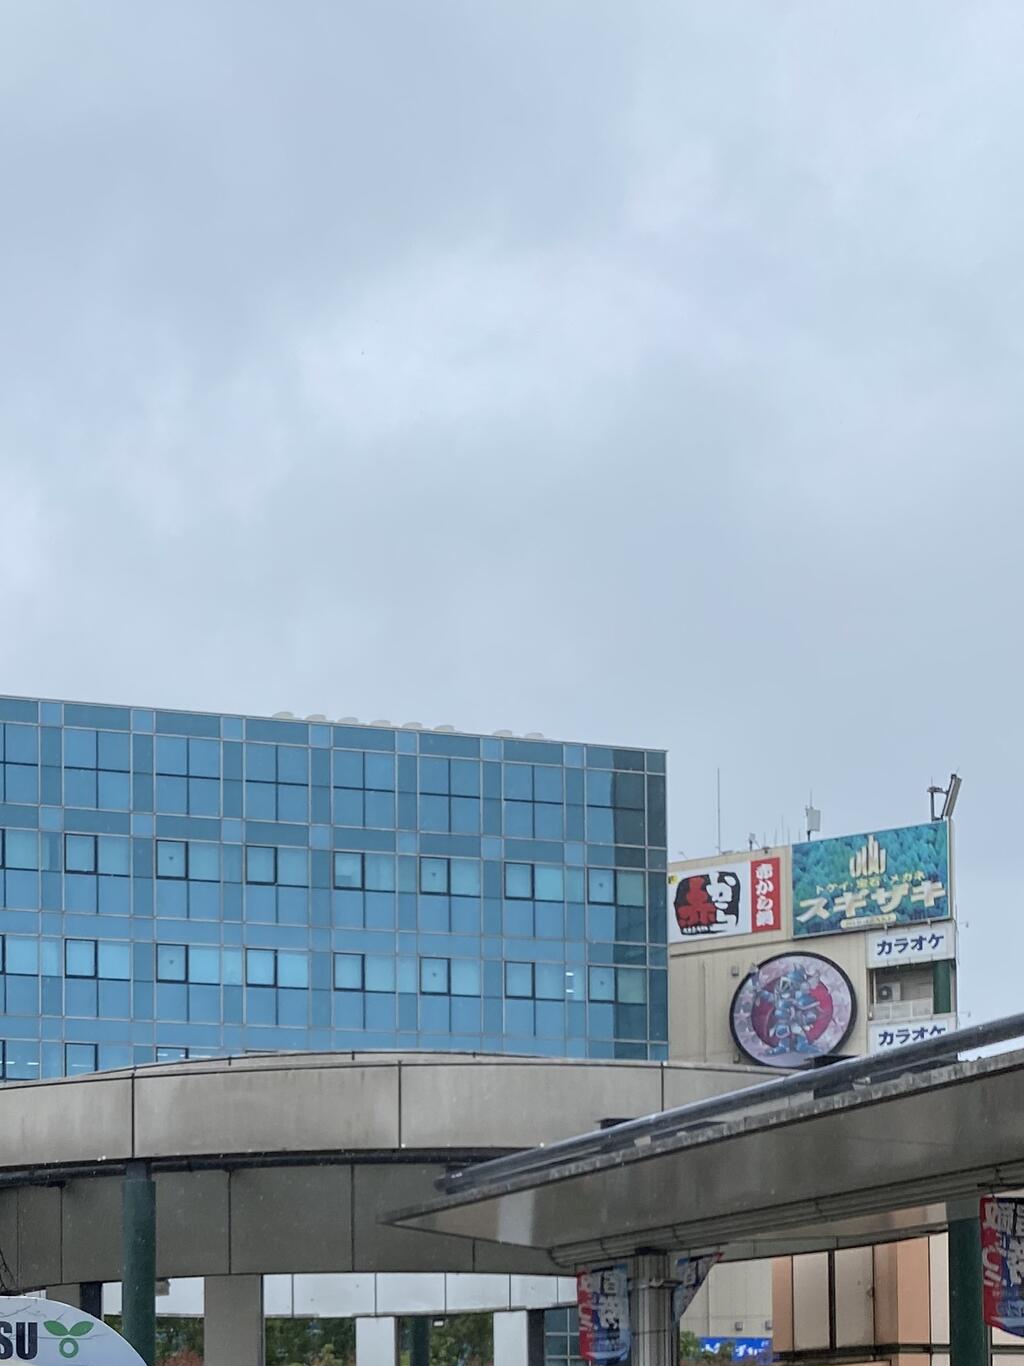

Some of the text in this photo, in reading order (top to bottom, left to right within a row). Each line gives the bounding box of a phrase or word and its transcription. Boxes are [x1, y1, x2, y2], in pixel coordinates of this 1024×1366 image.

[796, 881, 946, 923] スギザキ
[877, 934, 944, 956] カラオケ
